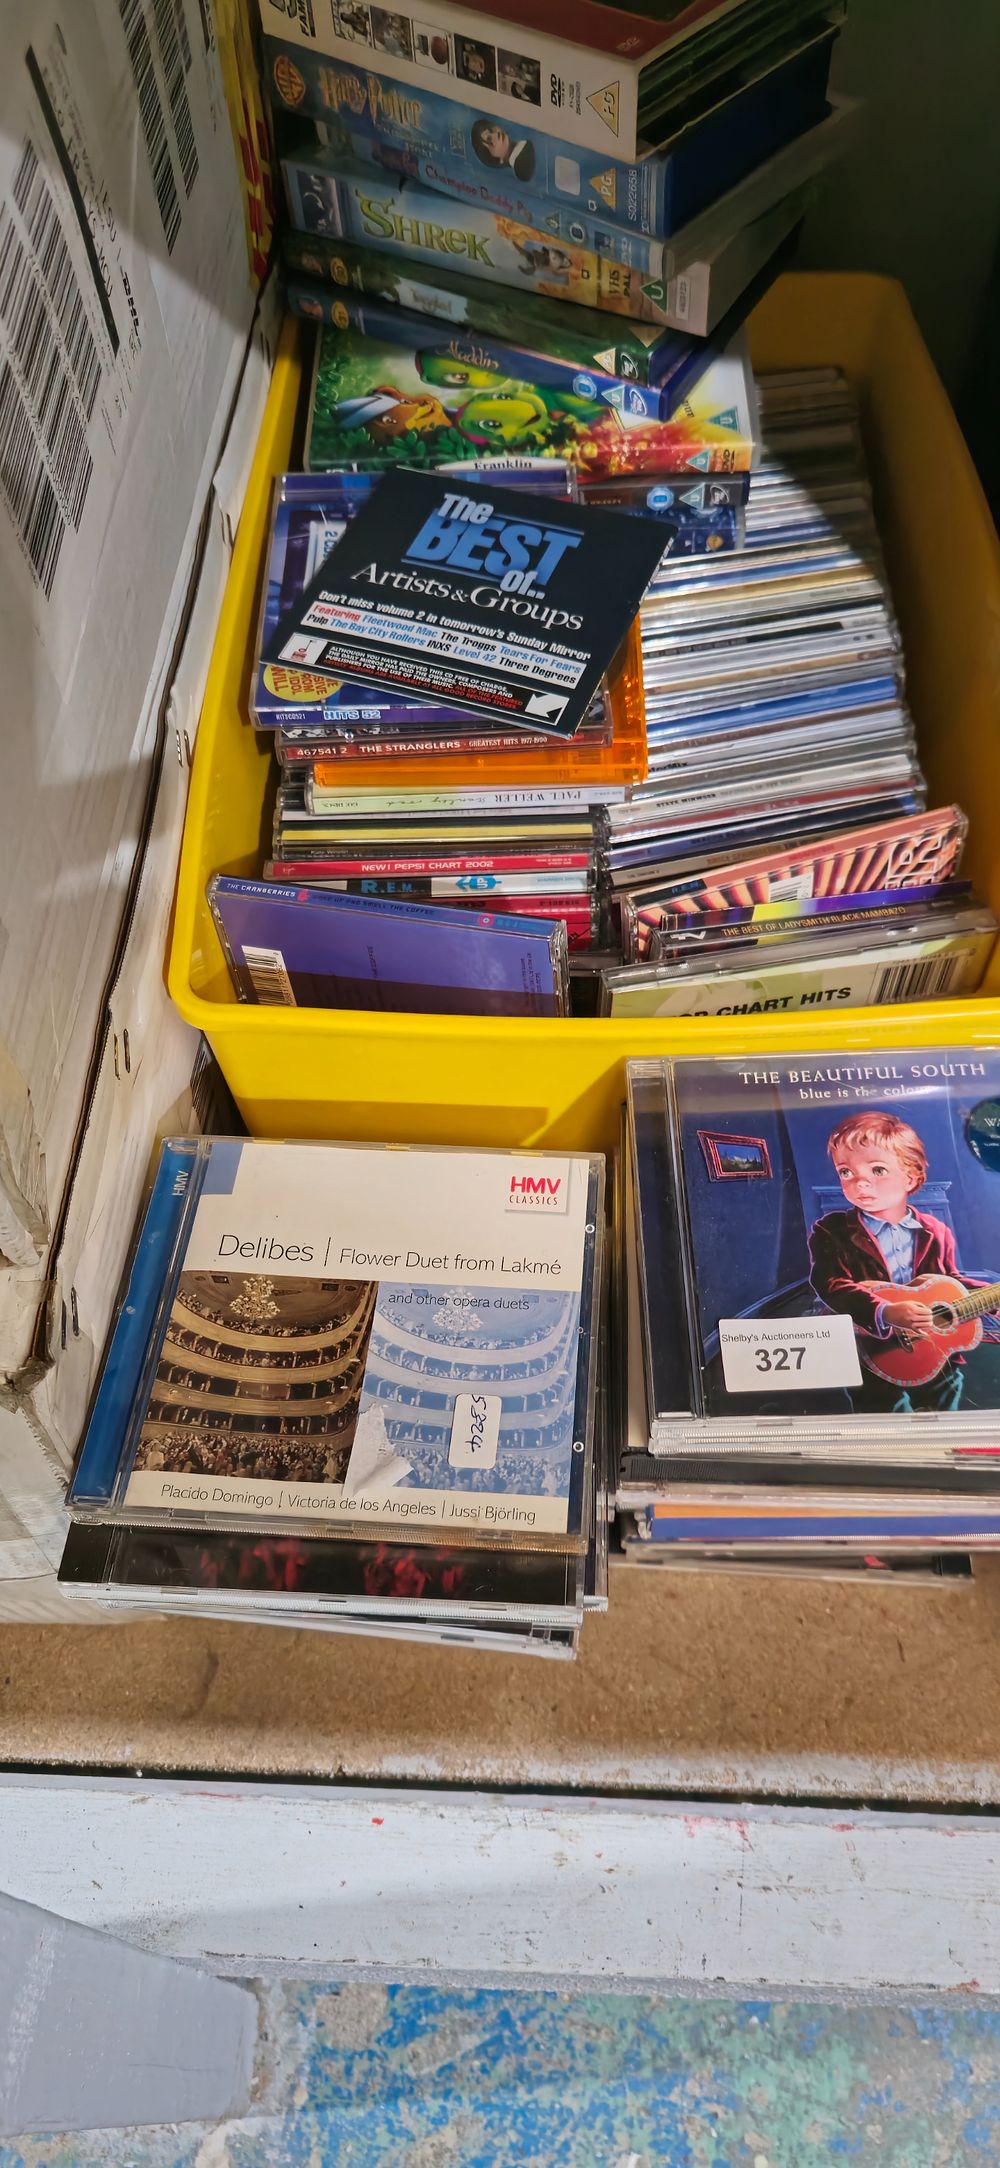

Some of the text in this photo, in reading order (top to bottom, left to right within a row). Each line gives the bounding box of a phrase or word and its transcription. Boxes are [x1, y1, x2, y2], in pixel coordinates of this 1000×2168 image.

[366, 72, 422, 129] Potter
[550, 73, 560, 107] DVD
[601, 175, 612, 197] PG
[435, 339, 500, 371] Aladdin
[474, 459, 533, 471] Franklin
[436, 493, 494, 525] The
[405, 508, 584, 586] BEST
[350, 562, 584, 631] Artists & Groups
[318, 590, 592, 661] Don't miss volume 2 in tomorrow's Sunday Mirror
[306, 614, 577, 685] Pulp The Bay City Rollers INXS Level 42 Three Degrees
[313, 604, 582, 674] Featuring Fleetwood Mac The Troggs Tears For Fears
[325, 655, 362, 667] PUBLISHERS
[363, 664, 376, 672] FOR
[413, 674, 431, 683] THEIR
[328, 650, 341, 658] THE
[341, 653, 359, 662] DAILY
[360, 657, 385, 667] MIRROR
[385, 663, 398, 671] HAS
[399, 665, 415, 674] PAID
[415, 670, 428, 679] THE
[458, 680, 498, 695] COMPOSERS
[498, 690, 514, 699] AND
[331, 646, 365, 658] ALTHOUGH
[366, 653, 380, 661] YOU
[381, 656, 398, 665] HAVE
[399, 661, 428, 673] RECEIVED
[429, 668, 443, 677] THIS
[454, 674, 470, 683] FREE
[470, 678, 480, 686] OF
[481, 682, 508, 693] CHARGE,
[444, 687, 465, 697] GOOD
[466, 692, 492, 704] RECORD
[324, 709, 381, 721] HITS 52
[297, 748, 337, 757] 467541
[340, 747, 349, 755] 2
[359, 744, 382, 754] THE
[385, 740, 461, 753] STRANGLERS
[468, 739, 501, 748] GREATEST
[503, 738, 519, 746] HITS
[495, 792, 545, 804] WELLER
[553, 789, 582, 801] PAUL
[656, 792, 717, 808] STEVE WINWOOD
[362, 860, 494, 872] NEW! PEPSI CHART 2002
[226, 883, 240, 891] THE
[241, 885, 296, 898] CRANBERRIES
[721, 906, 906, 937] THE BEST OF LADYSMITH BLACK MAMBAZO
[715, 996, 793, 1016] CHART
[800, 987, 852, 1004] HITS
[739, 1063, 986, 1085] THE BEAUTIFUL SOUTH
[799, 1088, 832, 1100] blue
[837, 1087, 849, 1099] is
[883, 1084, 930, 1096] colo
[172, 1170, 189, 1196] HMV
[510, 1175, 562, 1195] HMV
[509, 1194, 559, 1206] CLASSICS
[218, 1234, 562, 1275] Delibes Flower Duet from Lakmé
[388, 1292, 530, 1311] and other opera duets
[721, 1329, 831, 1344] Shelby's Auctioneers Ltd
[754, 1346, 807, 1372] 327
[160, 1483, 537, 1526] Placido Domingo Victoria de los Angeles Jussi Björling
